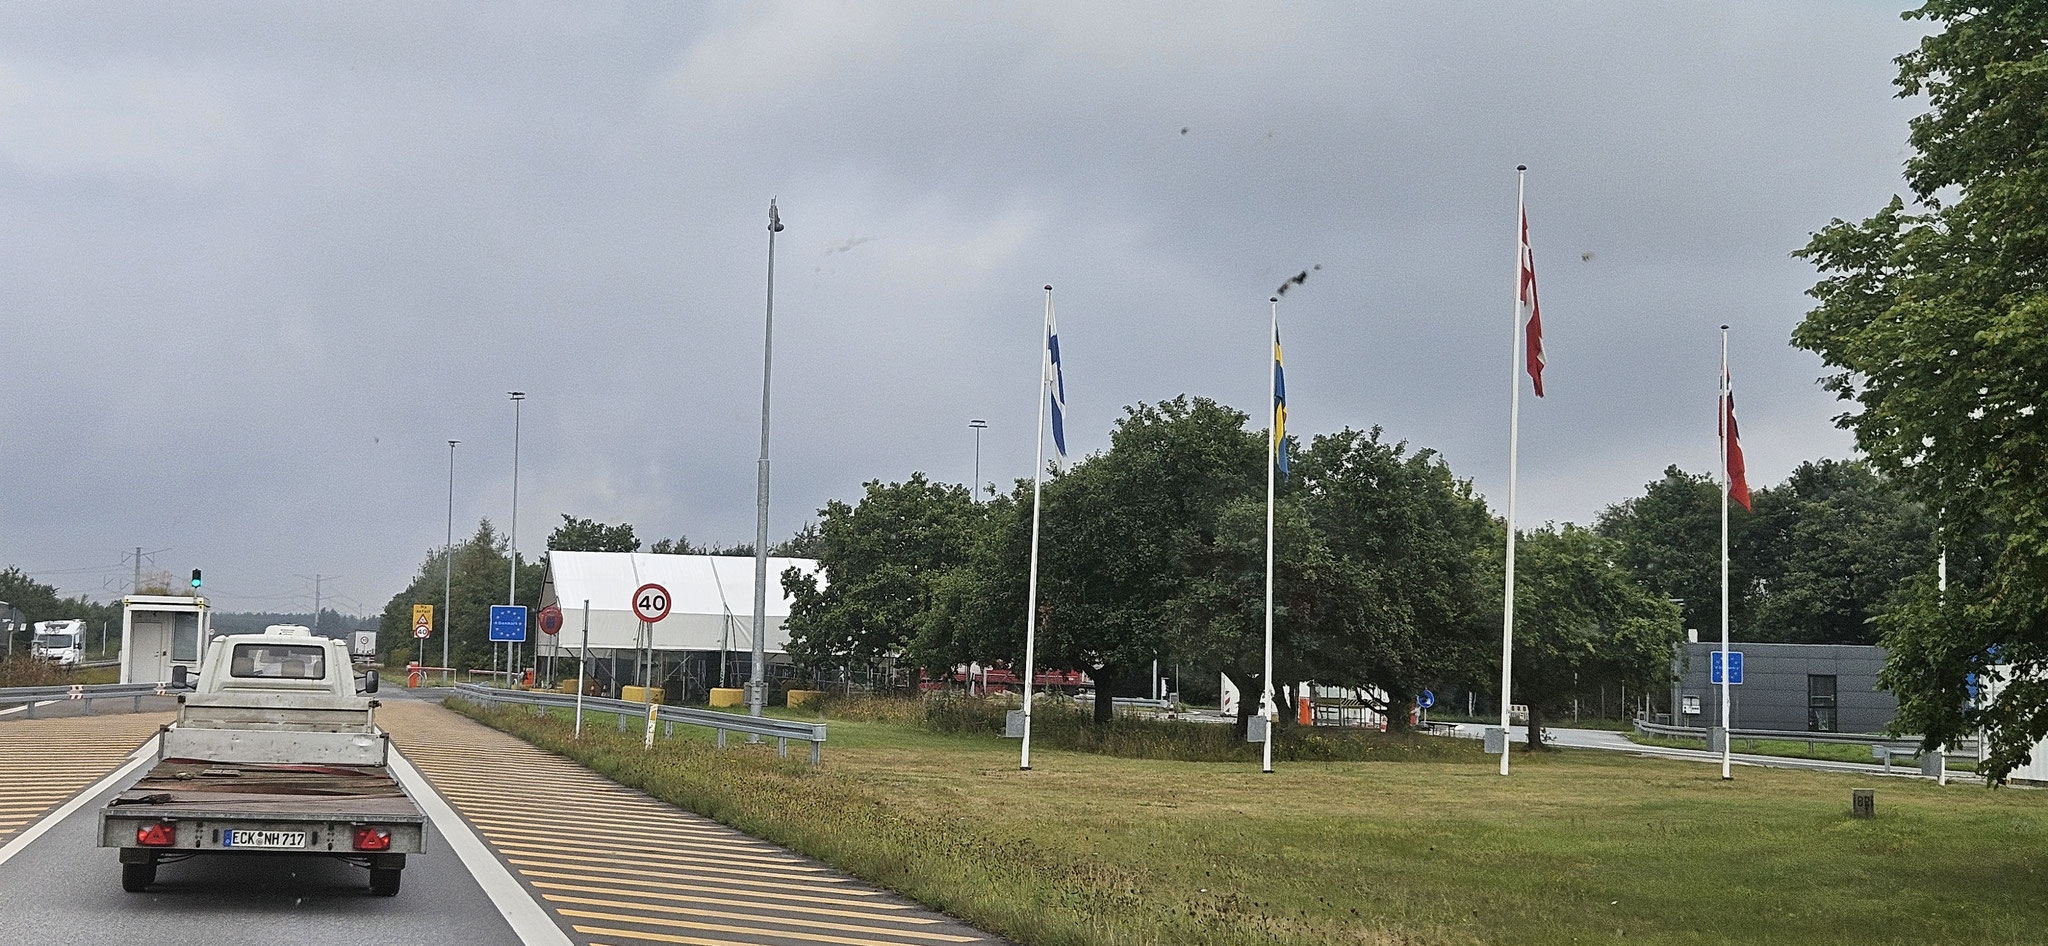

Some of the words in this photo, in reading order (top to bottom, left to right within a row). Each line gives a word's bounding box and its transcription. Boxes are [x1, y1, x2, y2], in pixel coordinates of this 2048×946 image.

[638, 595, 665, 611] 40
[232, 832, 255, 844] ECK
[264, 833, 279, 845] NH
[282, 833, 304, 846] 717
